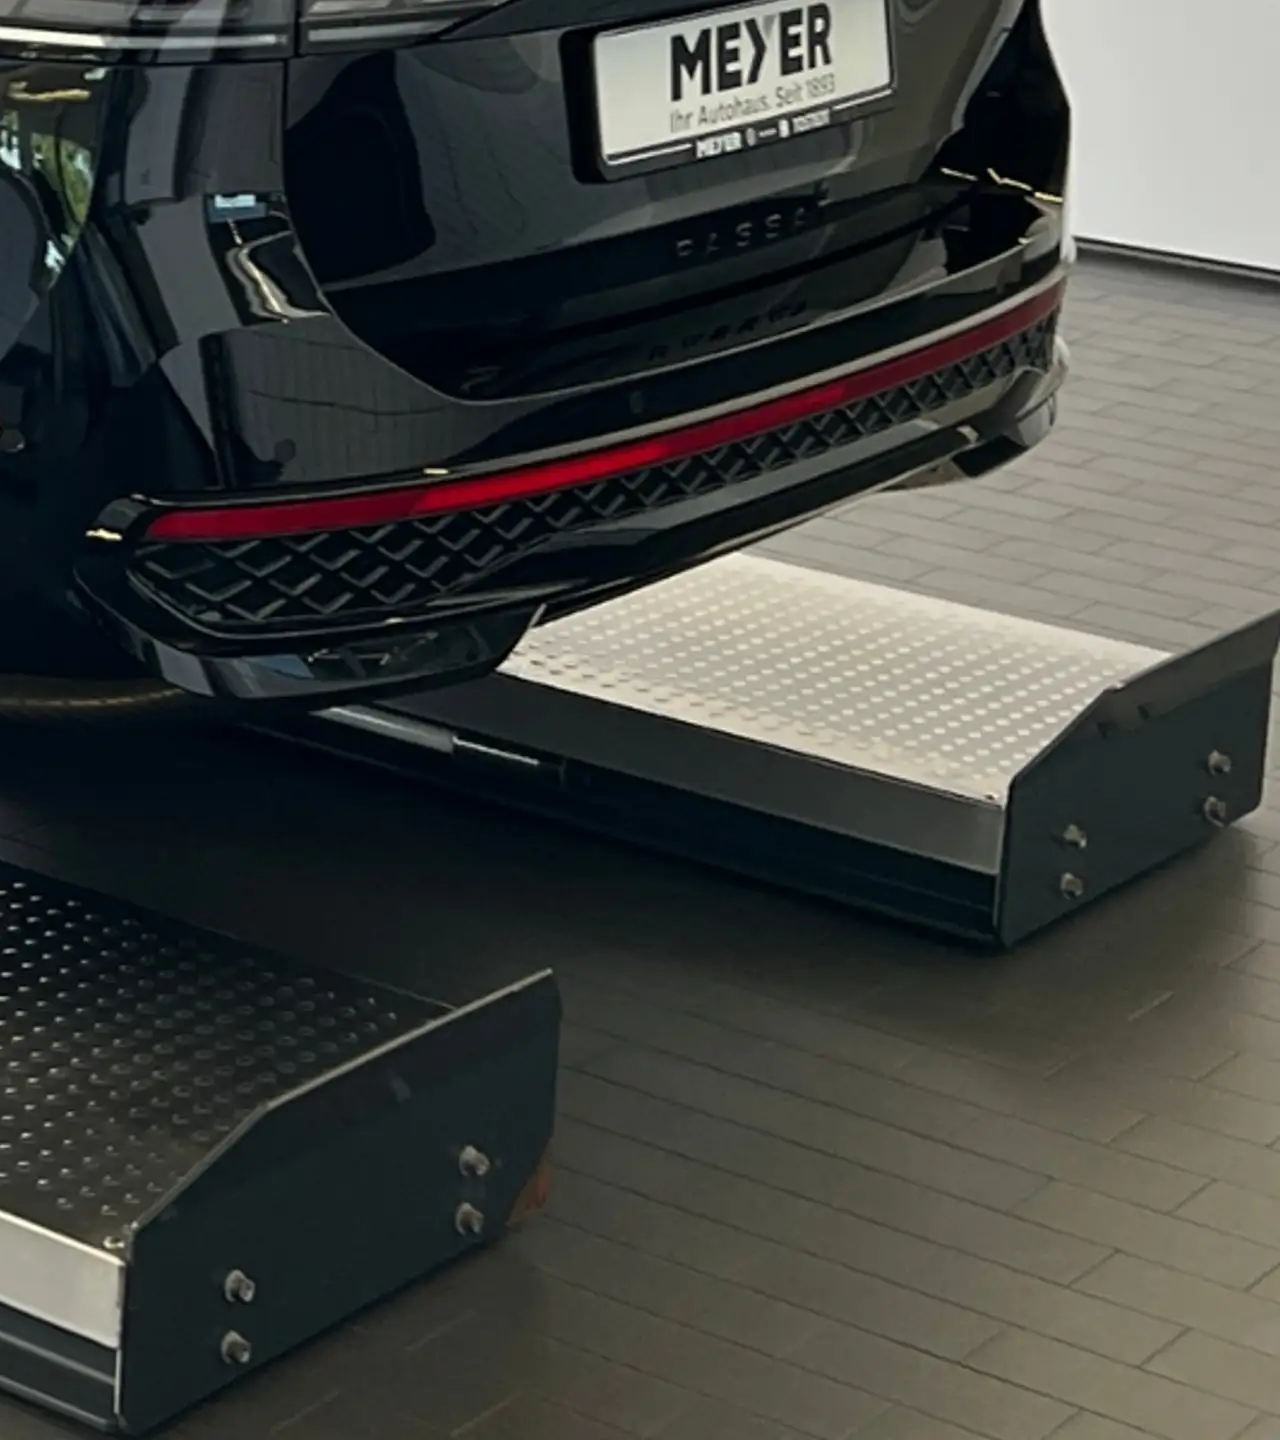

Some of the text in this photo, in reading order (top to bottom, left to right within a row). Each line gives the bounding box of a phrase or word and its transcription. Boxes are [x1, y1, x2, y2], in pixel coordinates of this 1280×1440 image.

[671, 3, 831, 101] MEYER
[670, 110, 692, 133] Ihr
[776, 83, 803, 108] Seit
